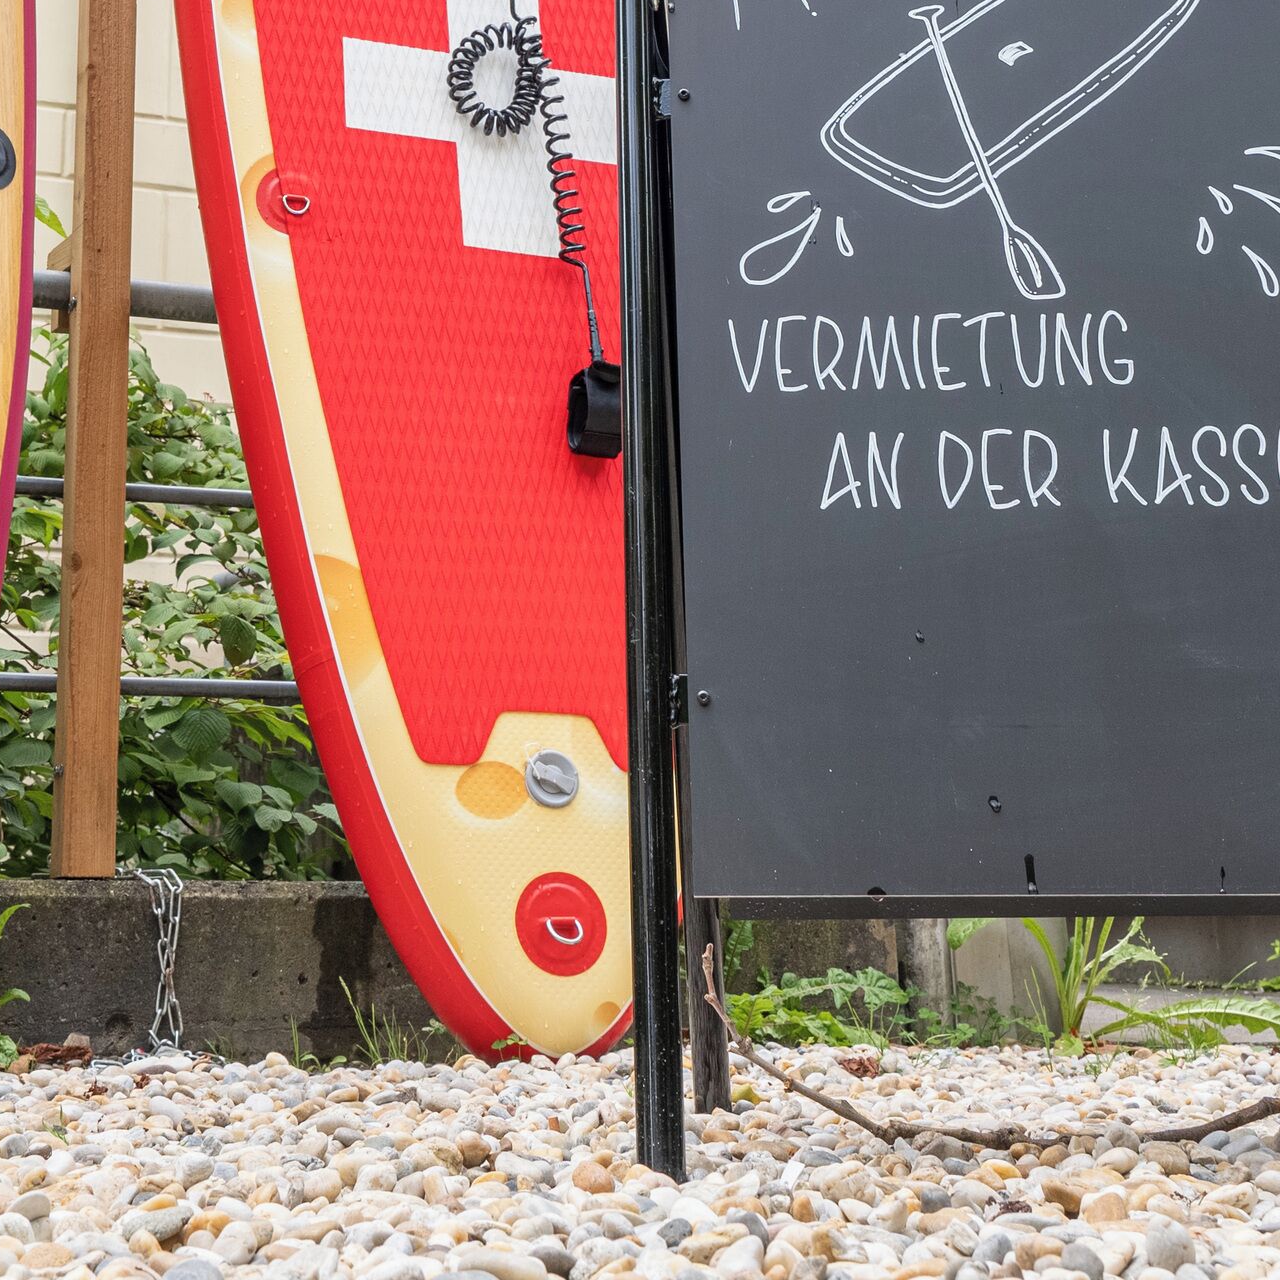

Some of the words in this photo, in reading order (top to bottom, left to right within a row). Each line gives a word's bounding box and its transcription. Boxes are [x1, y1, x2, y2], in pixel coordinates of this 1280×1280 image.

[727, 309, 1135, 393] VERMIETUNG
[819, 431, 905, 510] AN
[937, 428, 1062, 510] DER
